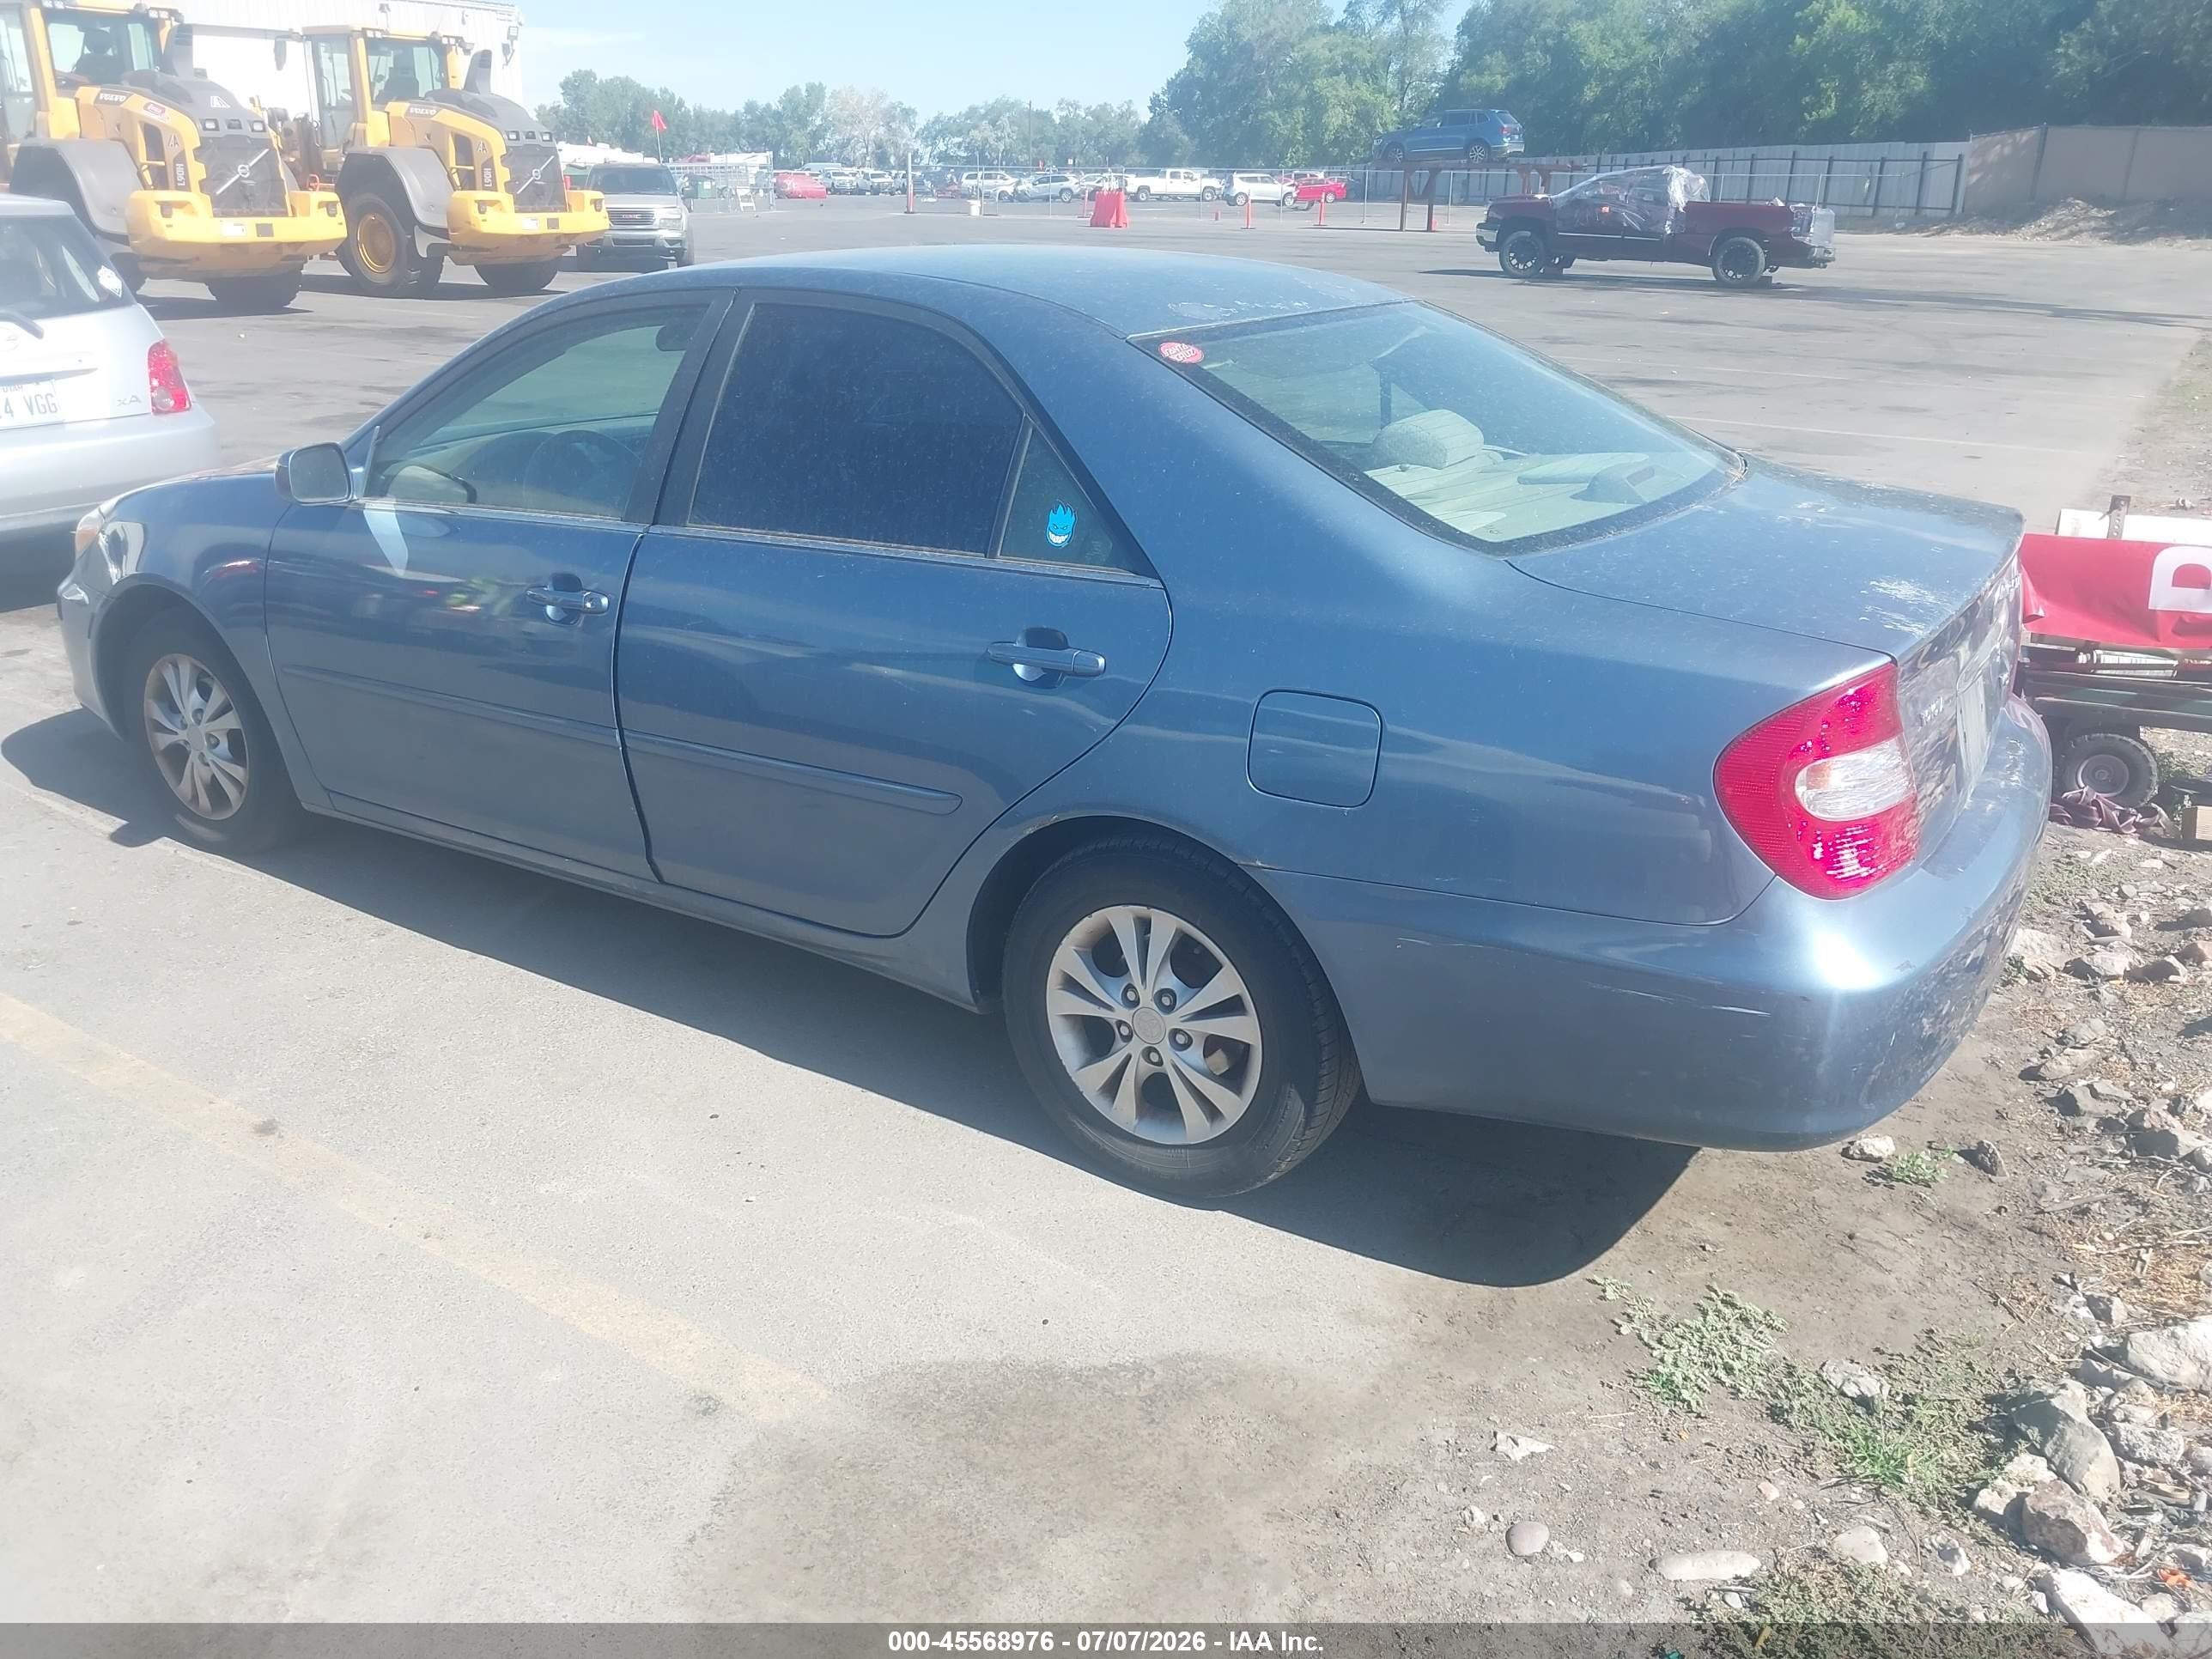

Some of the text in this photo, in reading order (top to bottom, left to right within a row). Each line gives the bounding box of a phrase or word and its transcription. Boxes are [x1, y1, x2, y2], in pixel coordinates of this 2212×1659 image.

[175, 163, 185, 186] L90H
[483, 167, 492, 187] L90H
[22, 392, 58, 416] VGG
